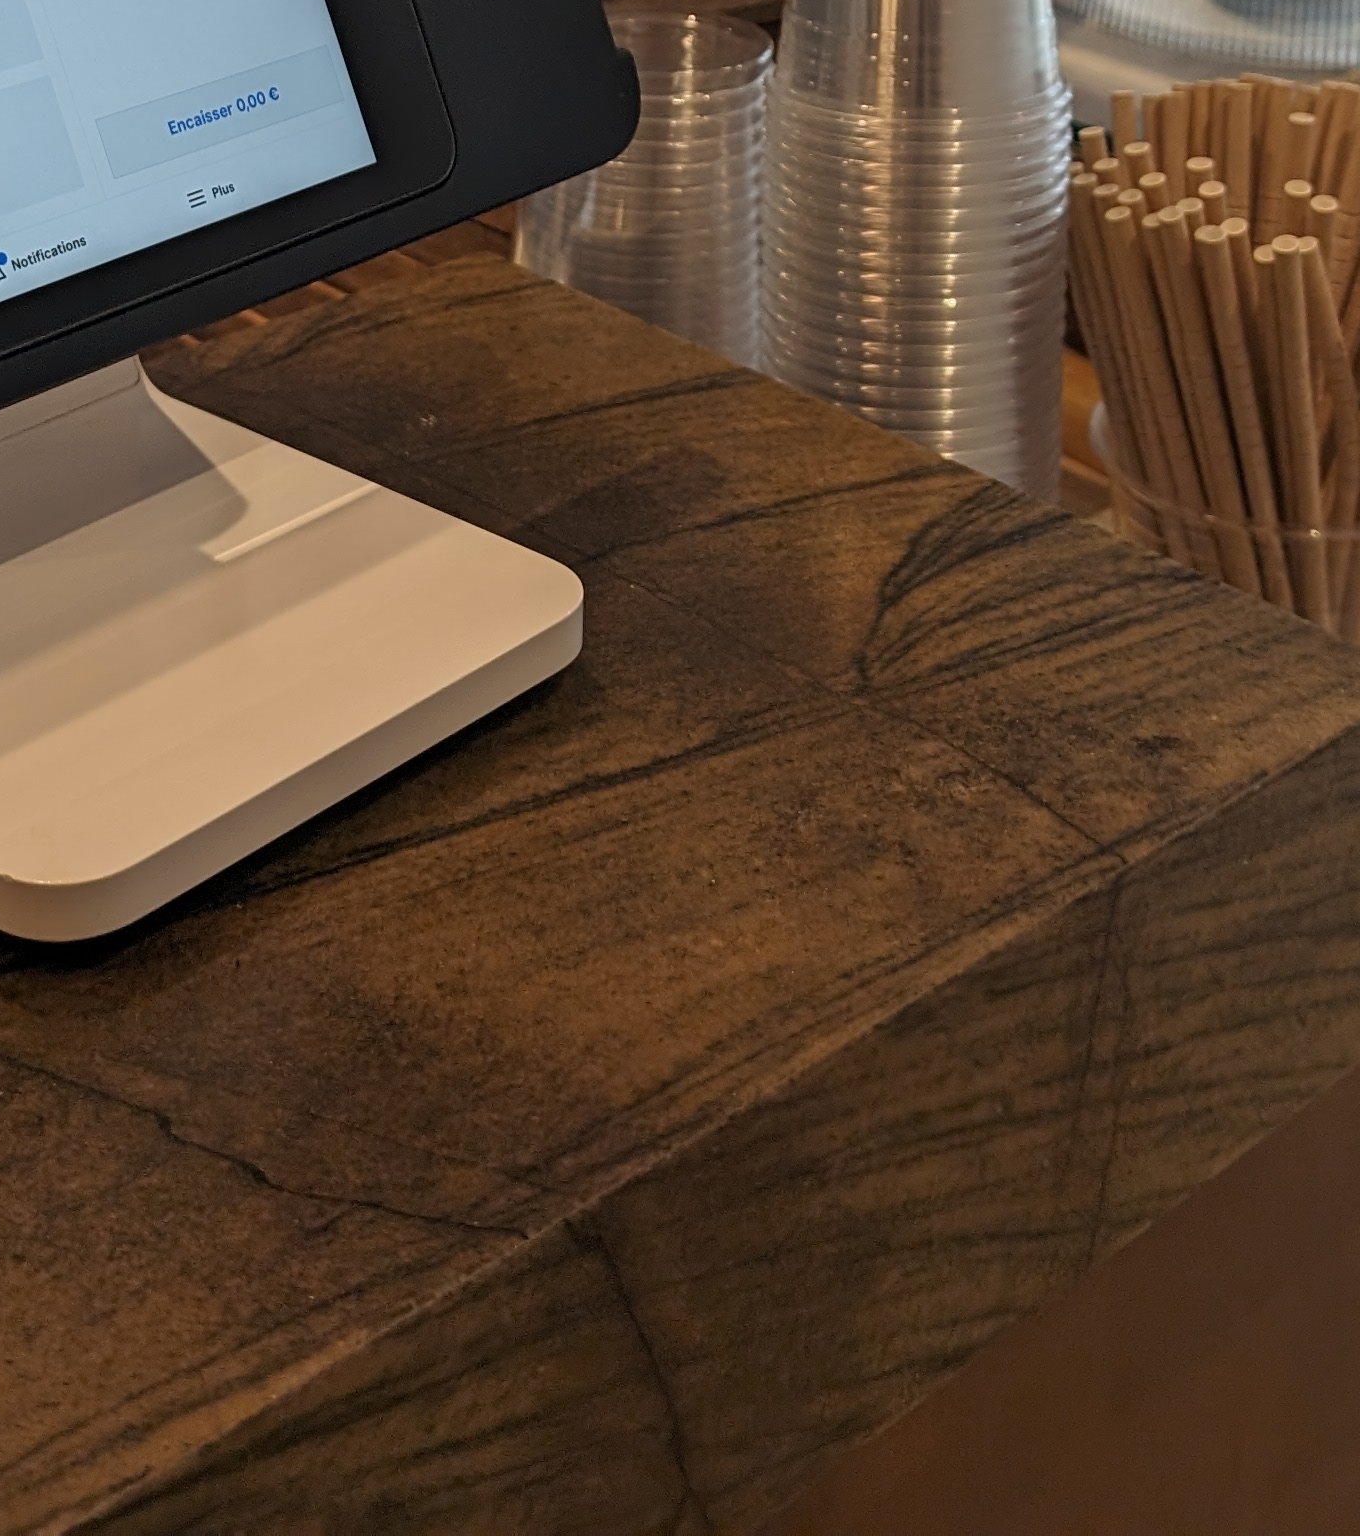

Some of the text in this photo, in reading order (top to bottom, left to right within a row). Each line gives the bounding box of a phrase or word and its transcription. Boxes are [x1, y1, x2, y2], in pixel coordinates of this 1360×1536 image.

[167, 86, 280, 135] Encaisser 0,00 €
[211, 183, 236, 199] Plus
[11, 234, 87, 272] Notifications
